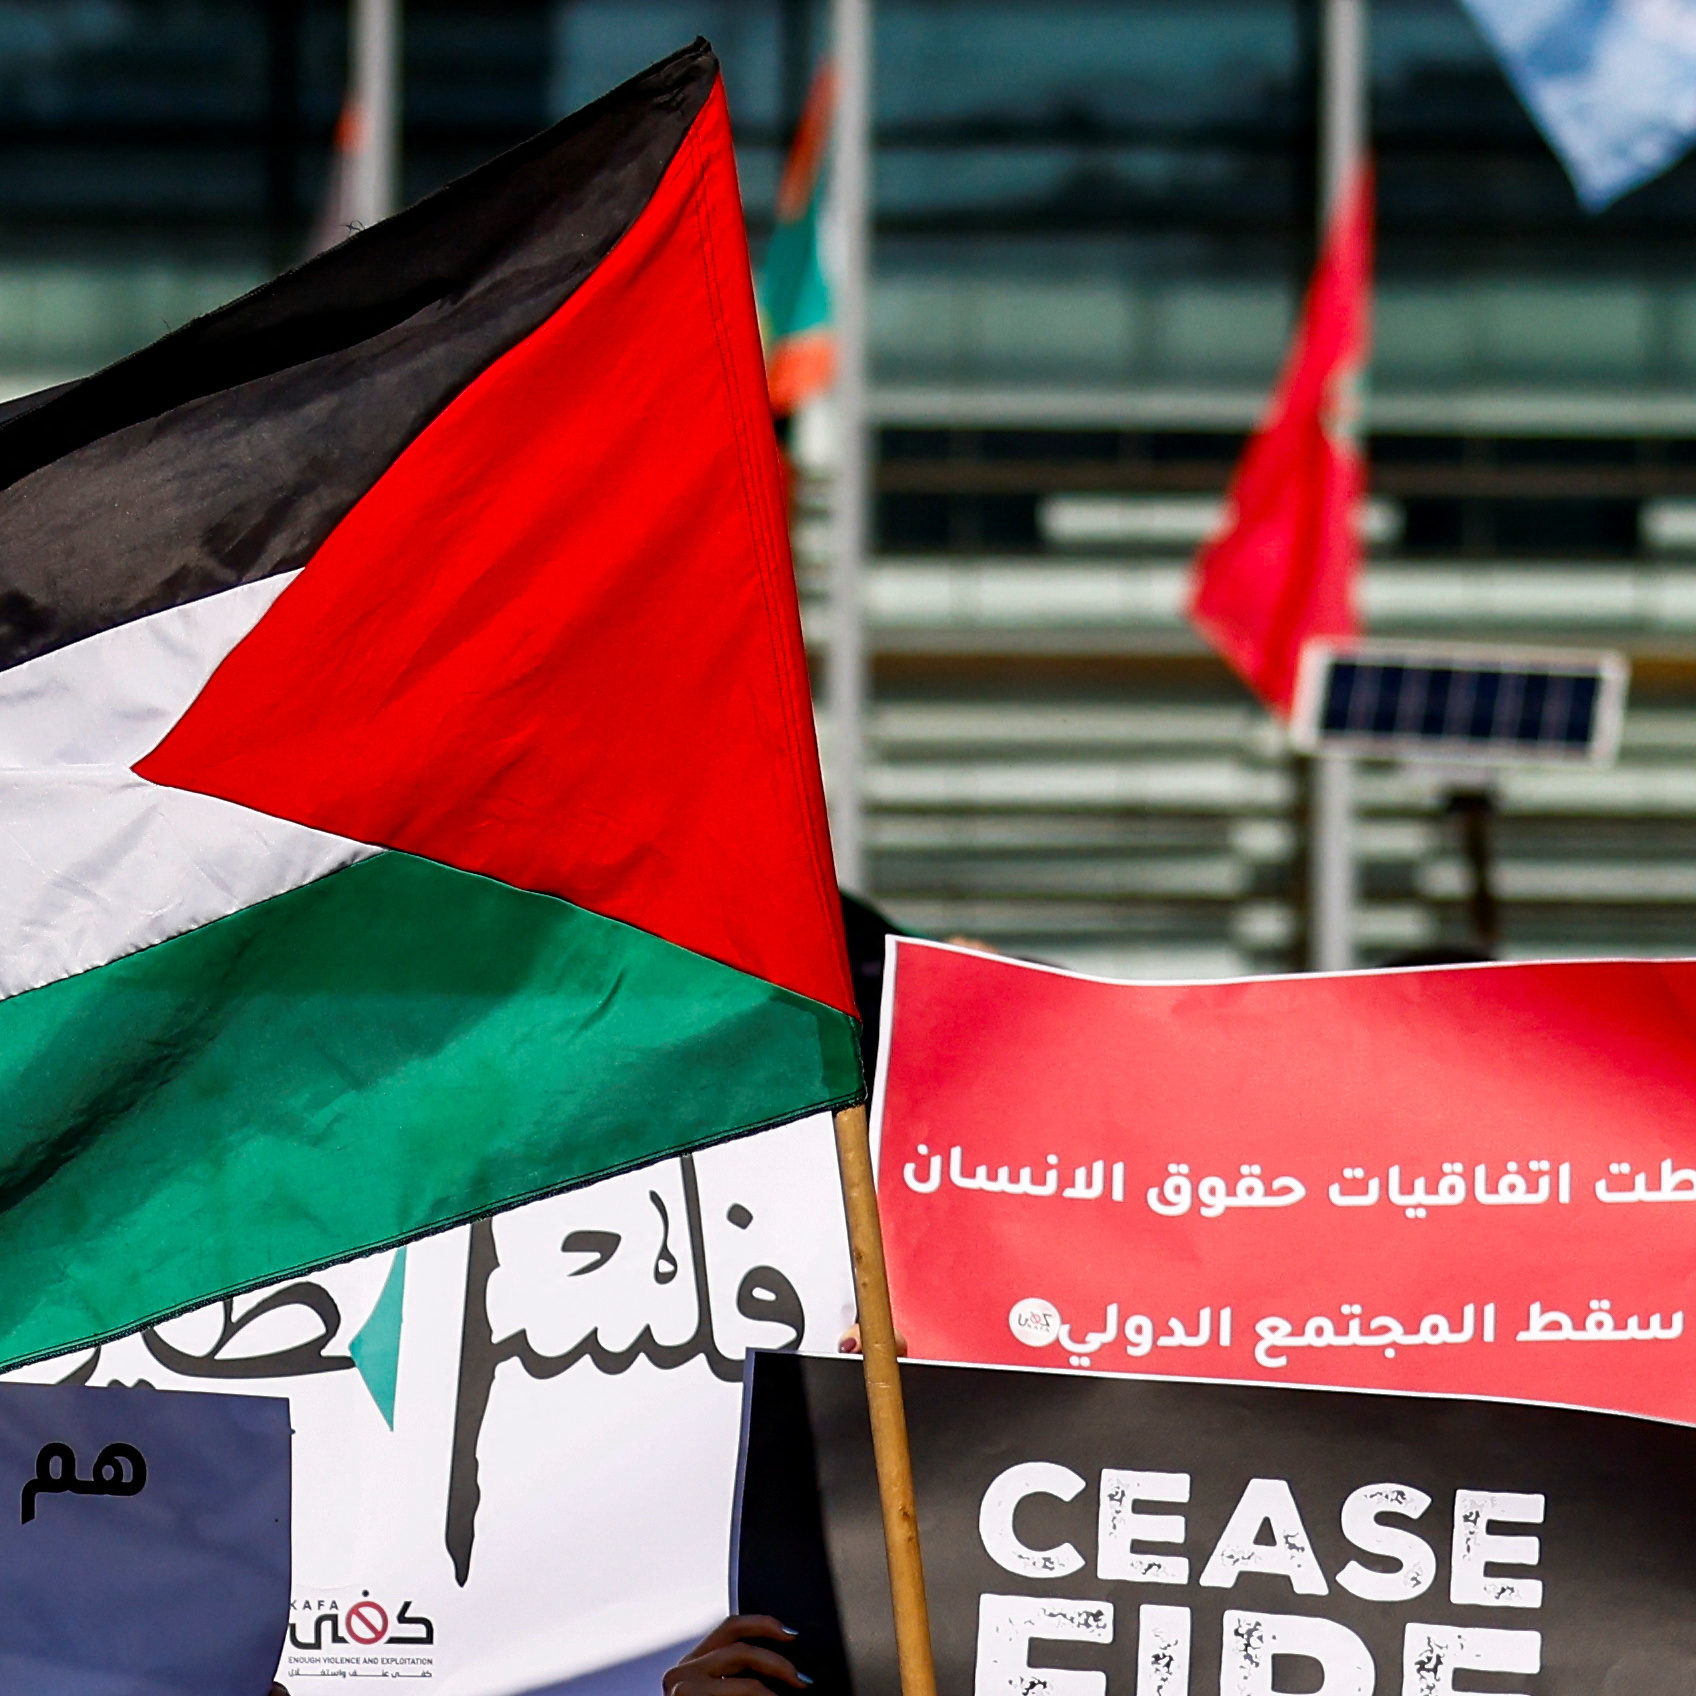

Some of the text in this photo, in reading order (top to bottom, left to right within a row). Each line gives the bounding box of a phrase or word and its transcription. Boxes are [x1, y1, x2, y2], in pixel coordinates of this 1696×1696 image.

[903, 1144, 1125, 1202] الانسان
[1146, 1162, 1307, 1218] حقوق
[1328, 1159, 1572, 1219] اتفاقيات
[1058, 1299, 1685, 1368] سقط المجتمع الدولي
[21, 1442, 147, 1525] هم
[978, 1461, 1545, 1609] CEASE
[288, 1655, 433, 1666] ENOUGH VIOLENCE AND EXPLOITATION
